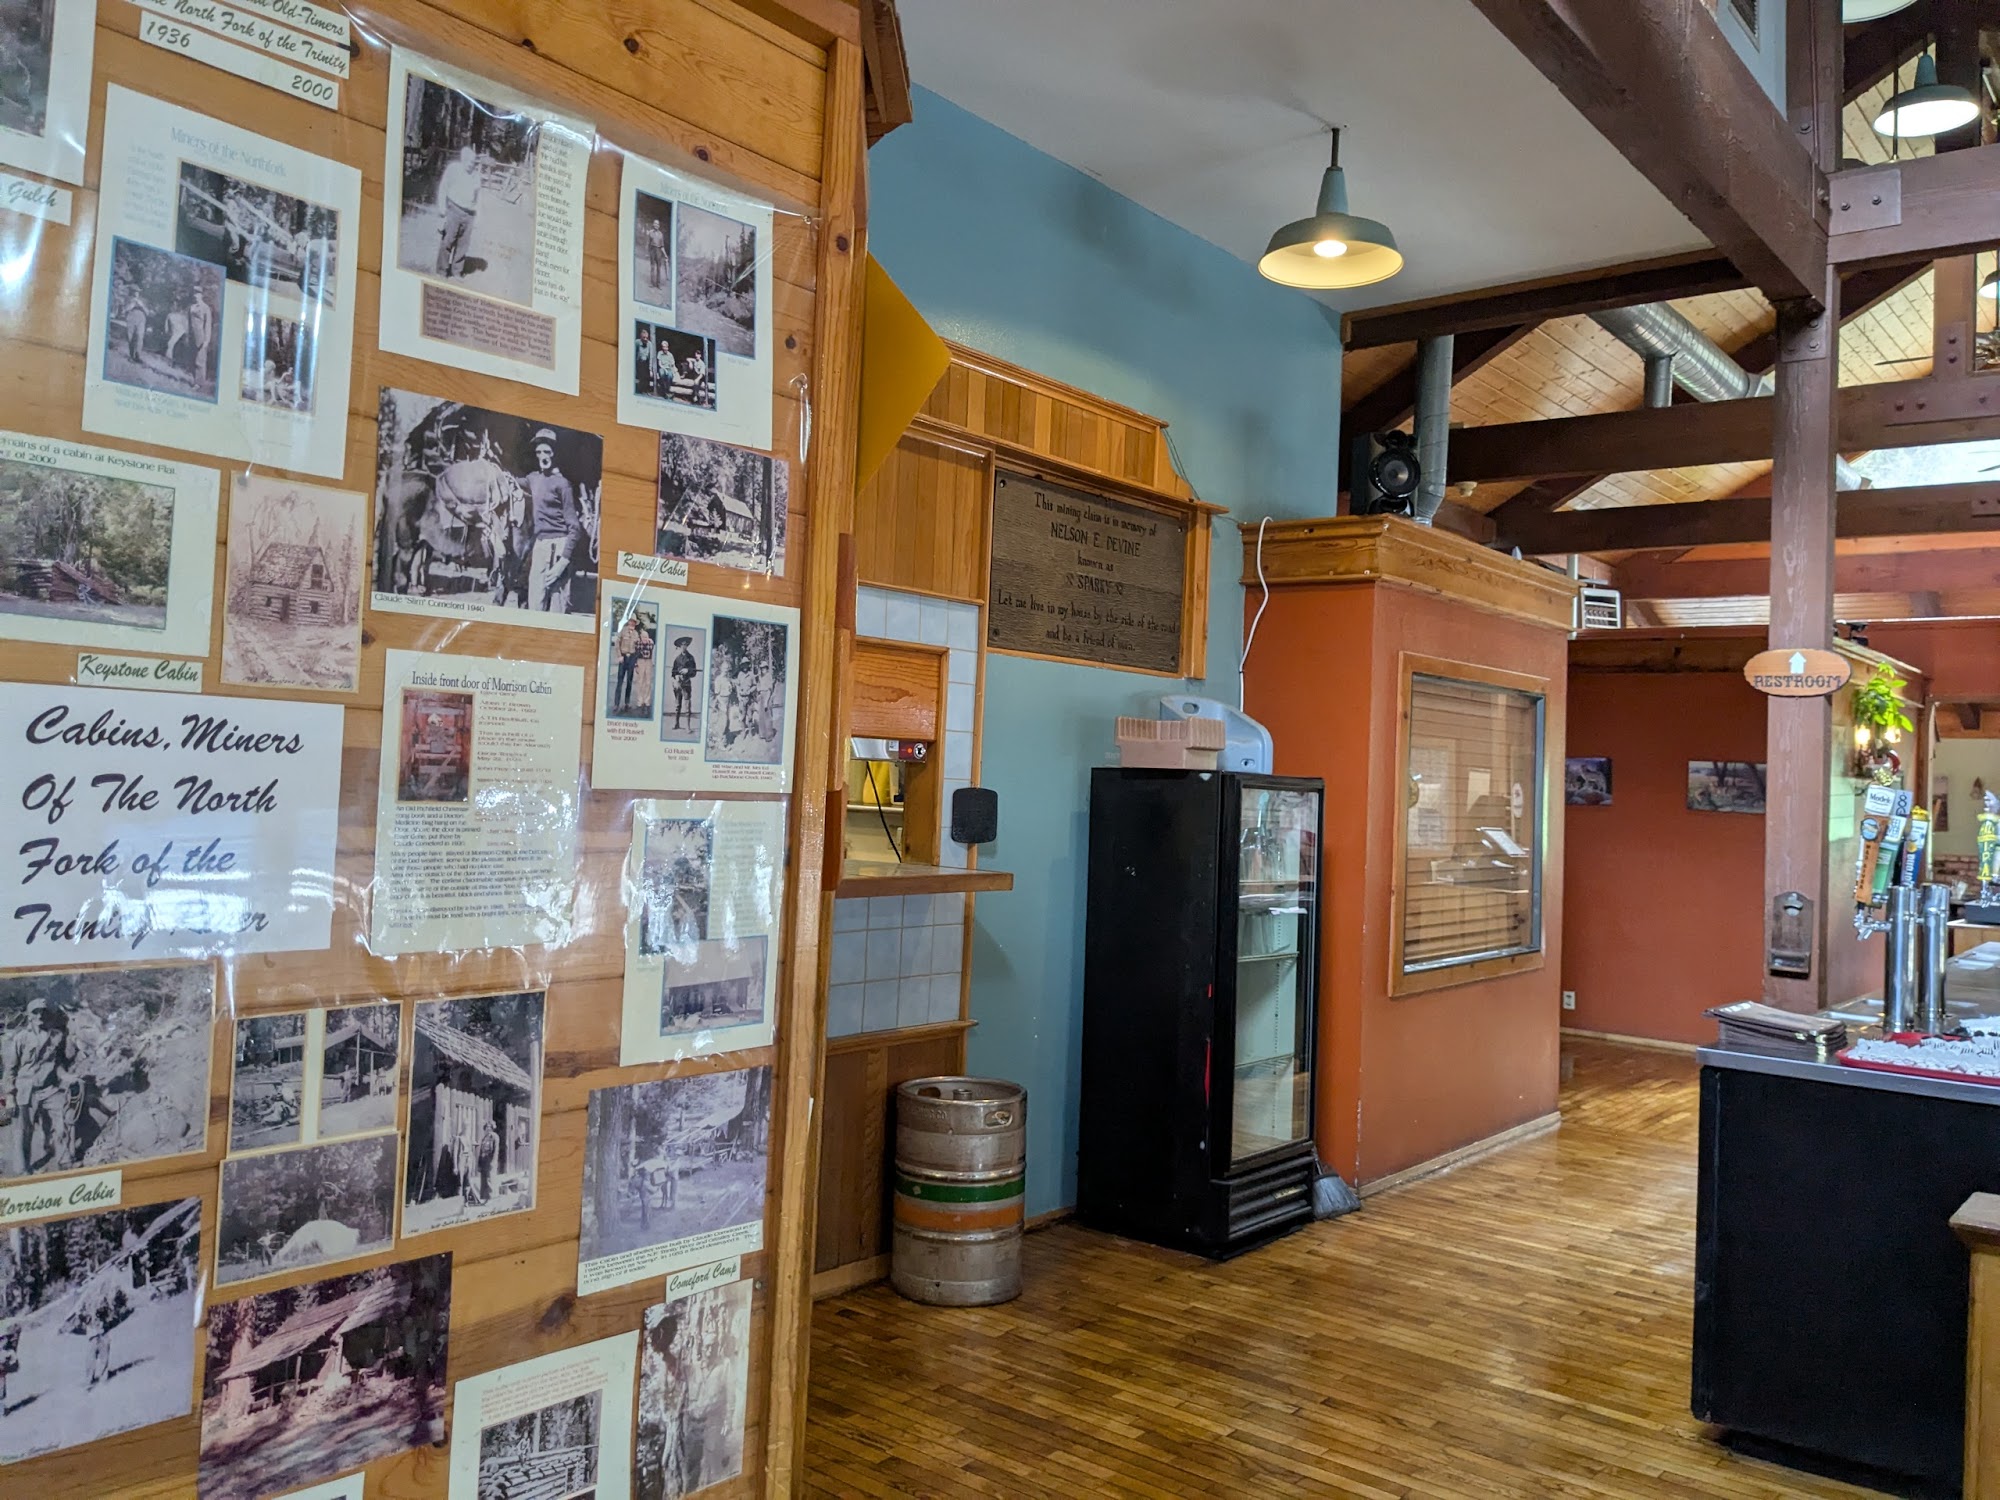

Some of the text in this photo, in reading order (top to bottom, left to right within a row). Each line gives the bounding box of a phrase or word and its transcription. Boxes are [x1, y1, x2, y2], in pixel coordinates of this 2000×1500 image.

[147, 22, 191, 48] 1936
[221, 12, 255, 37] Fork
[258, 30, 274, 48] of
[276, 34, 297, 51] the
[302, 41, 346, 73] Trinity
[292, 75, 334, 100] 2000
[8, 181, 58, 207] Gulch
[15, 451, 25, 459] of
[29, 453, 57, 465] 2000
[39, 443, 51, 453] of
[54, 446, 60, 454] a
[63, 447, 92, 460] cabin
[95, 453, 105, 462] at
[107, 455, 155, 471] Keystone
[1034, 491, 1054, 511] This
[1056, 504, 1081, 523] mining
[1083, 507, 1102, 523] claim
[1104, 514, 1111, 525] is
[1149, 523, 1158, 537] of
[1051, 522, 1088, 545] NELSON
[623, 553, 686, 576] Russell Cabin
[1077, 550, 1114, 572] known as
[374, 592, 402, 603] Claude
[998, 588, 1012, 606] Let
[1015, 598, 1026, 608] me
[80, 654, 199, 682] Keystone Cabin
[412, 671, 552, 694] Inside front door of Morrison Cabin
[1754, 675, 1842, 689] RESTROOM
[26, 705, 305, 754] Cabins, Miners
[22, 773, 279, 824] Of The North
[19, 837, 236, 887] Fork of the
[69, 1181, 116, 1205] Cabin
[669, 1260, 737, 1293] Comeford Camp
